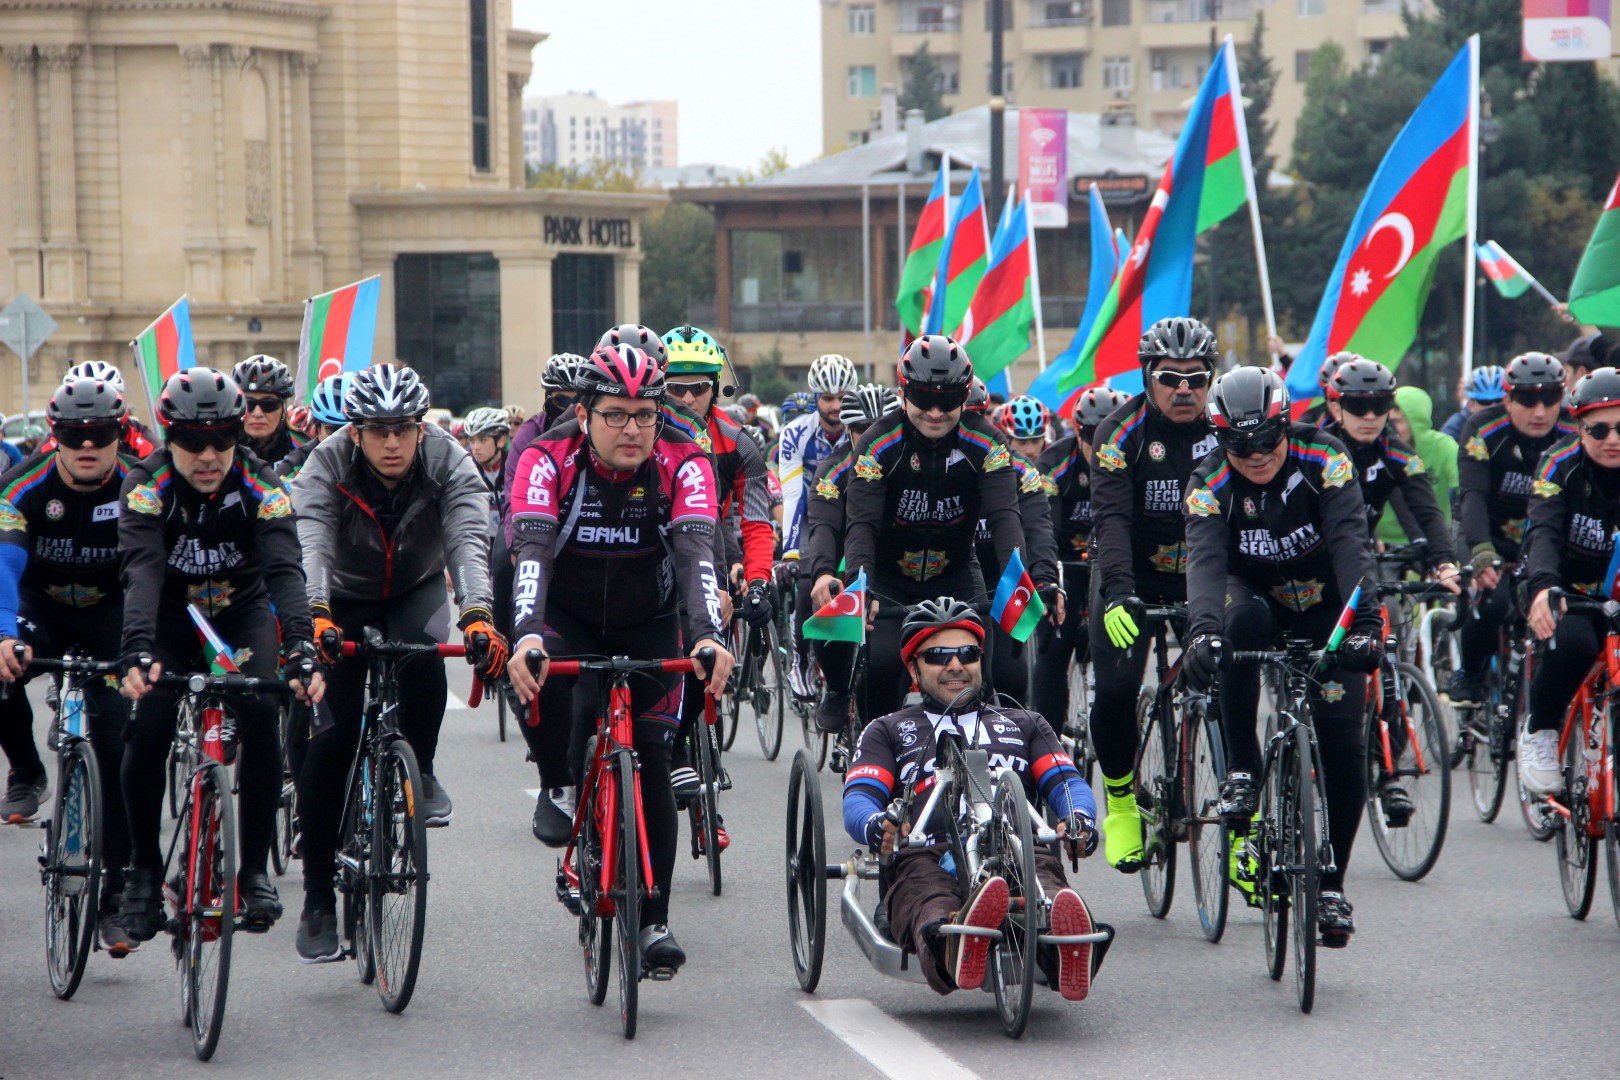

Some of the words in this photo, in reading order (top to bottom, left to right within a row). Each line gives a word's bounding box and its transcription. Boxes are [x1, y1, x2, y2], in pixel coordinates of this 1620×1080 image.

[544, 215, 582, 244] PARK
[588, 217, 635, 247] HOTEL
[596, 384, 620, 394] BBB
[1237, 418, 1259, 428] GIRO
[1146, 480, 1179, 490] STATE
[1145, 490, 1181, 502] SECU
[96, 507, 114, 517] DTX
[1573, 513, 1602, 530] STATE
[577, 525, 639, 544] BAKU
[1240, 529, 1272, 542] STATE
